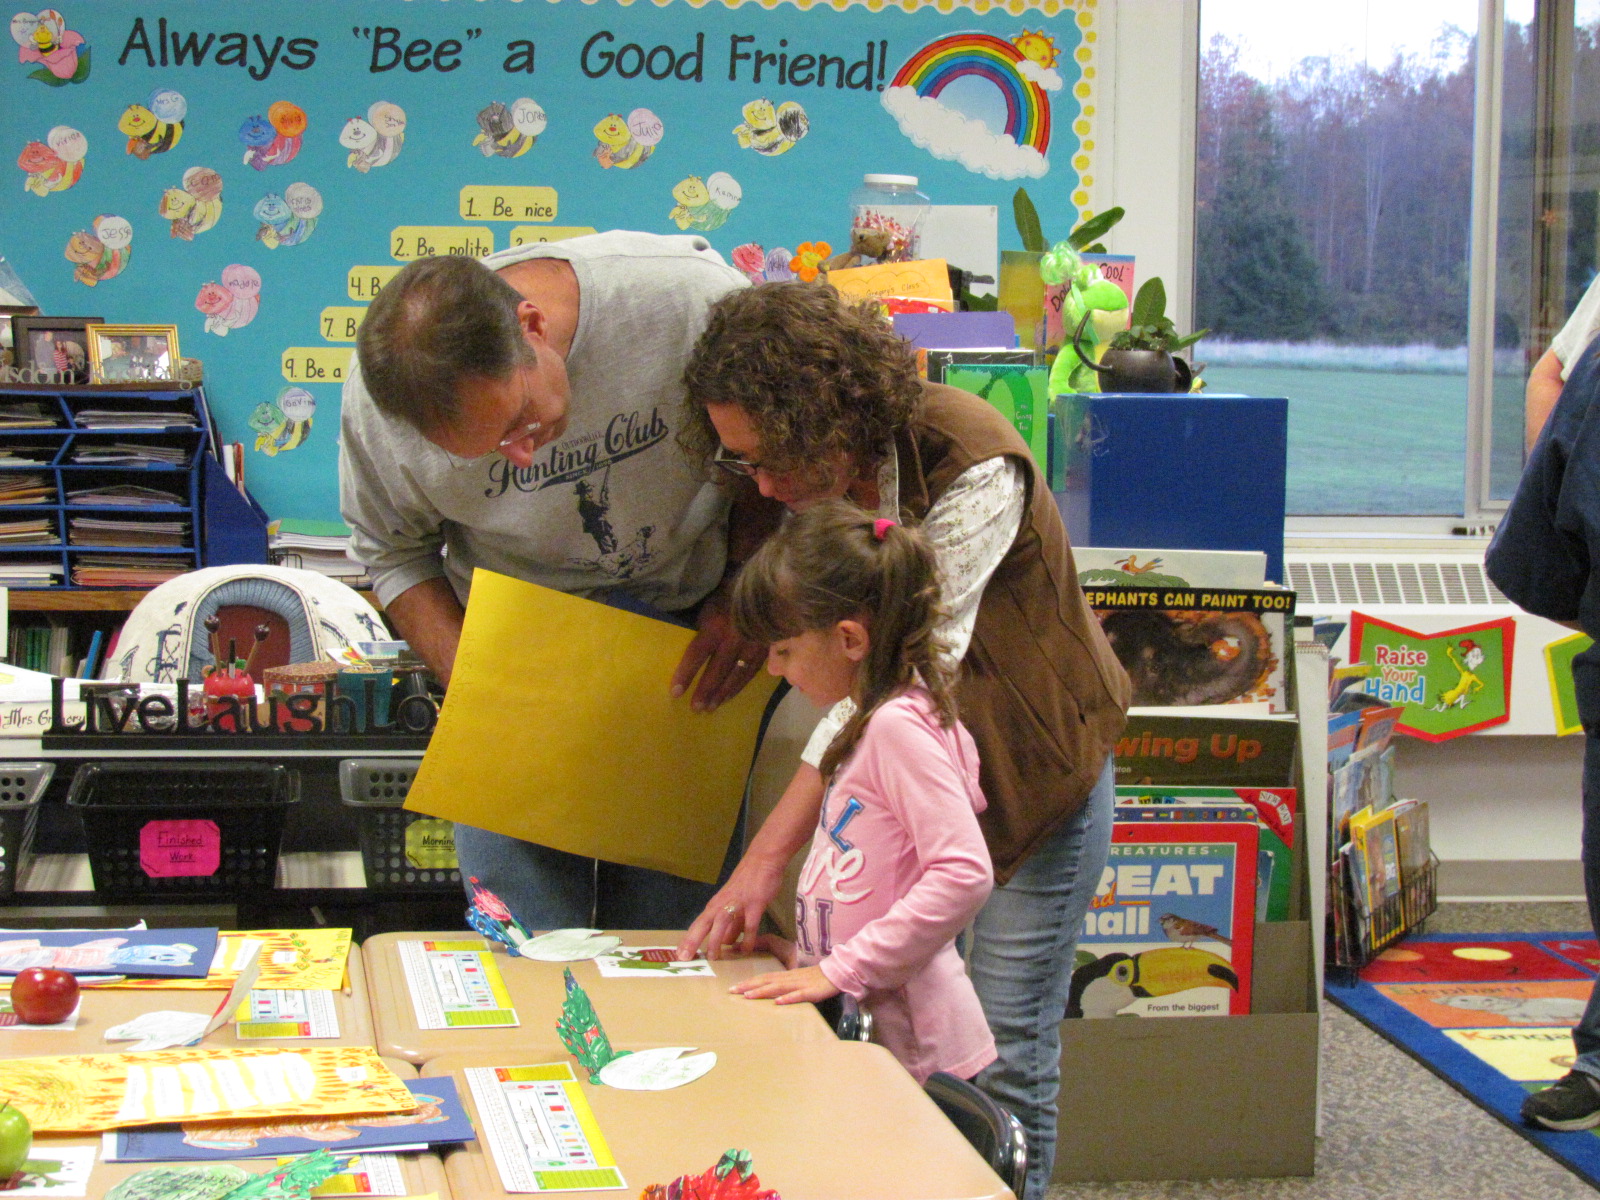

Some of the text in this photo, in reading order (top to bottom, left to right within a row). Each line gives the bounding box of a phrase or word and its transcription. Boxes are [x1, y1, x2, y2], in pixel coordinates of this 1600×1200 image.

[118, 17, 318, 81] Always
[502, 39, 535, 74] a
[580, 30, 705, 82] Good
[728, 34, 889, 92] Friend!
[632, 122, 662, 137] Julia
[466, 197, 553, 217] 1. Be nice
[394, 237, 490, 257] 2. Be polite
[351, 276, 382, 297] 4. B
[324, 317, 356, 337] 7. B
[0, 359, 76, 385] isdom
[285, 358, 342, 378] 9. Be a
[484, 407, 668, 499] Hunting Club
[1086, 592, 1291, 609] EPHANTS CAN PAINT TOO!
[1376, 645, 1427, 666] Raise
[1382, 668, 1416, 683] Your
[1365, 677, 1425, 703] Hand
[362, 677, 438, 734] Lo
[38, 709, 85, 728] Grory
[1113, 731, 1262, 764] wing Up
[157, 831, 203, 846] Finished
[170, 852, 195, 862] Work
[1111, 845, 1210, 856] REATURES
[1096, 864, 1224, 896] REAT
[1080, 906, 1150, 936] mall
[1389, 986, 1526, 996] Elephant
[1147, 1003, 1220, 1014] From the biggest
[1459, 1031, 1573, 1042] Kanga
